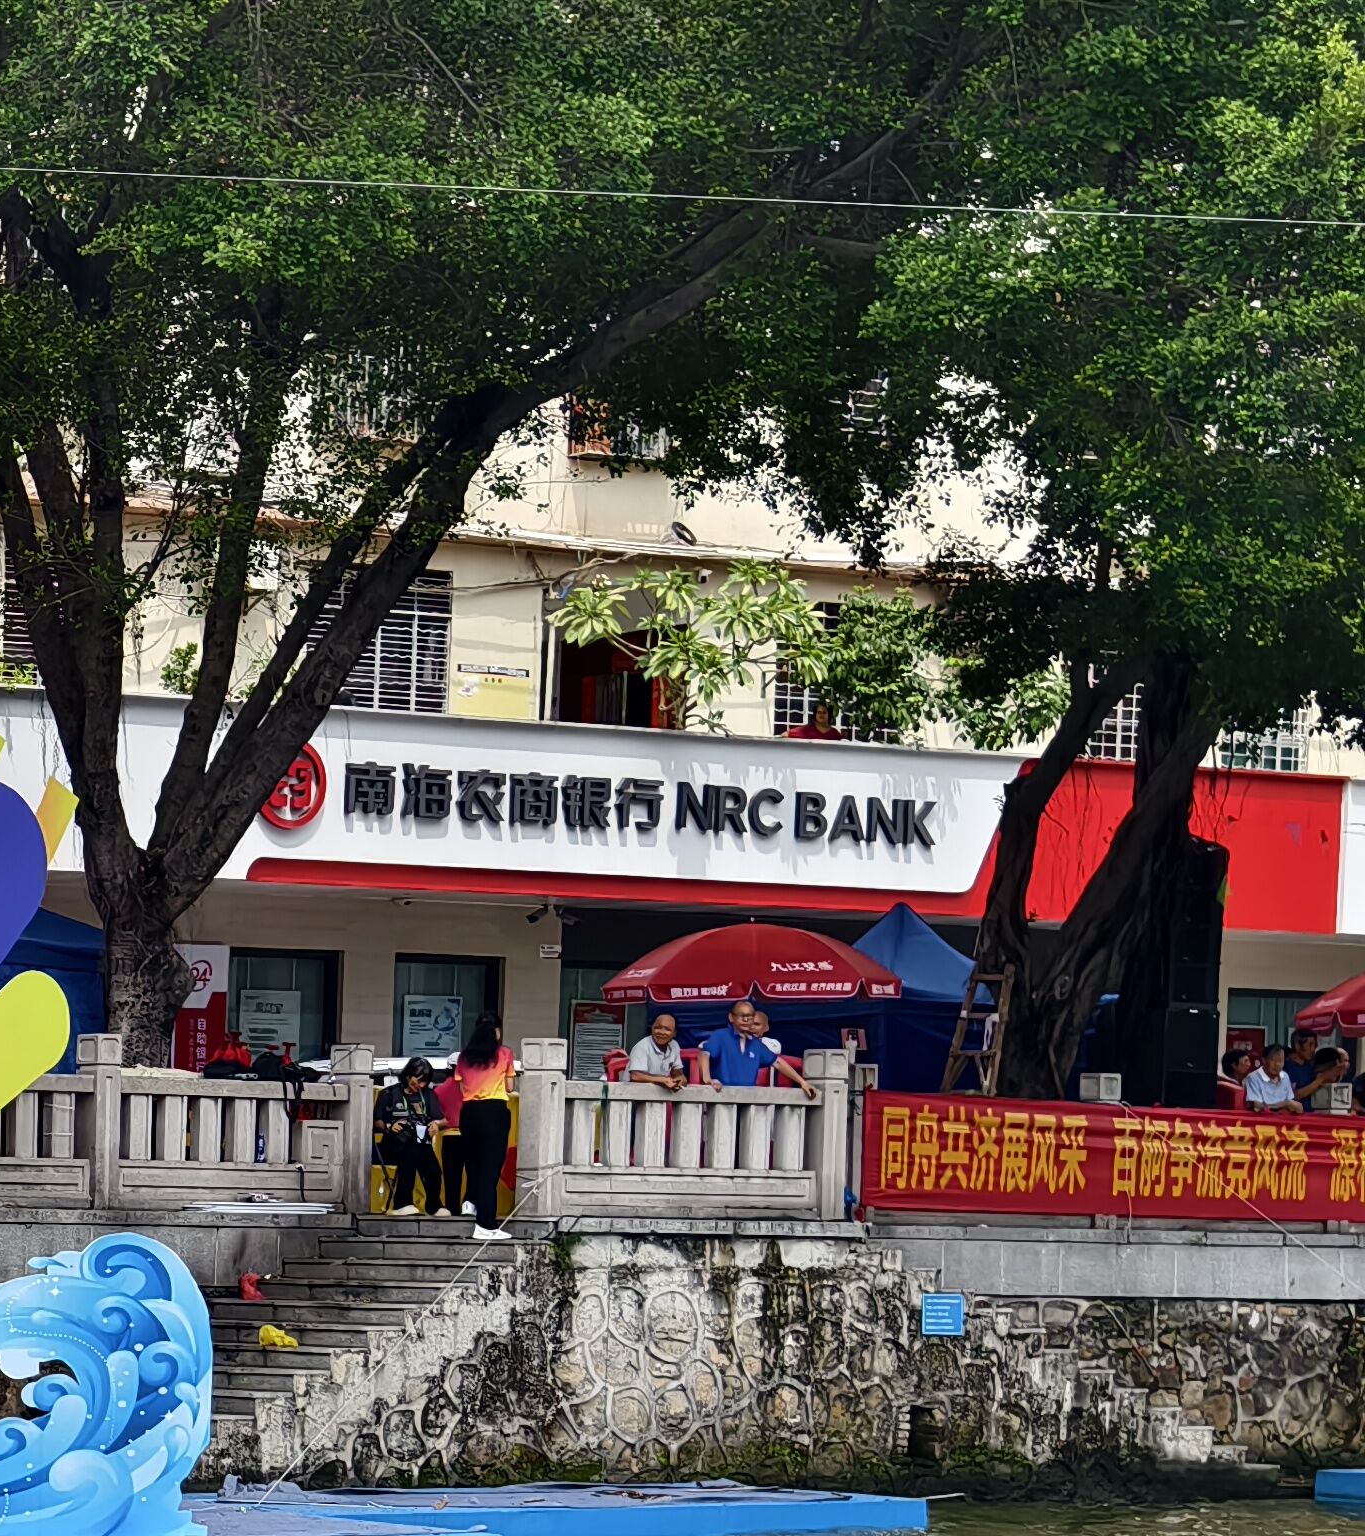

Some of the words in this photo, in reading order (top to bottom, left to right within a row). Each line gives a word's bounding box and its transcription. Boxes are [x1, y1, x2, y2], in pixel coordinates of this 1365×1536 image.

[344, 760, 665, 830] 南海农商银行
[675, 781, 785, 837] NRC
[794, 791, 938, 846] BANK
[880, 1103, 1088, 1195] 同舟共济展风采
[1112, 1115, 1310, 1201] 百舸争流竞风流
[1329, 1126, 1365, 1204] 源
